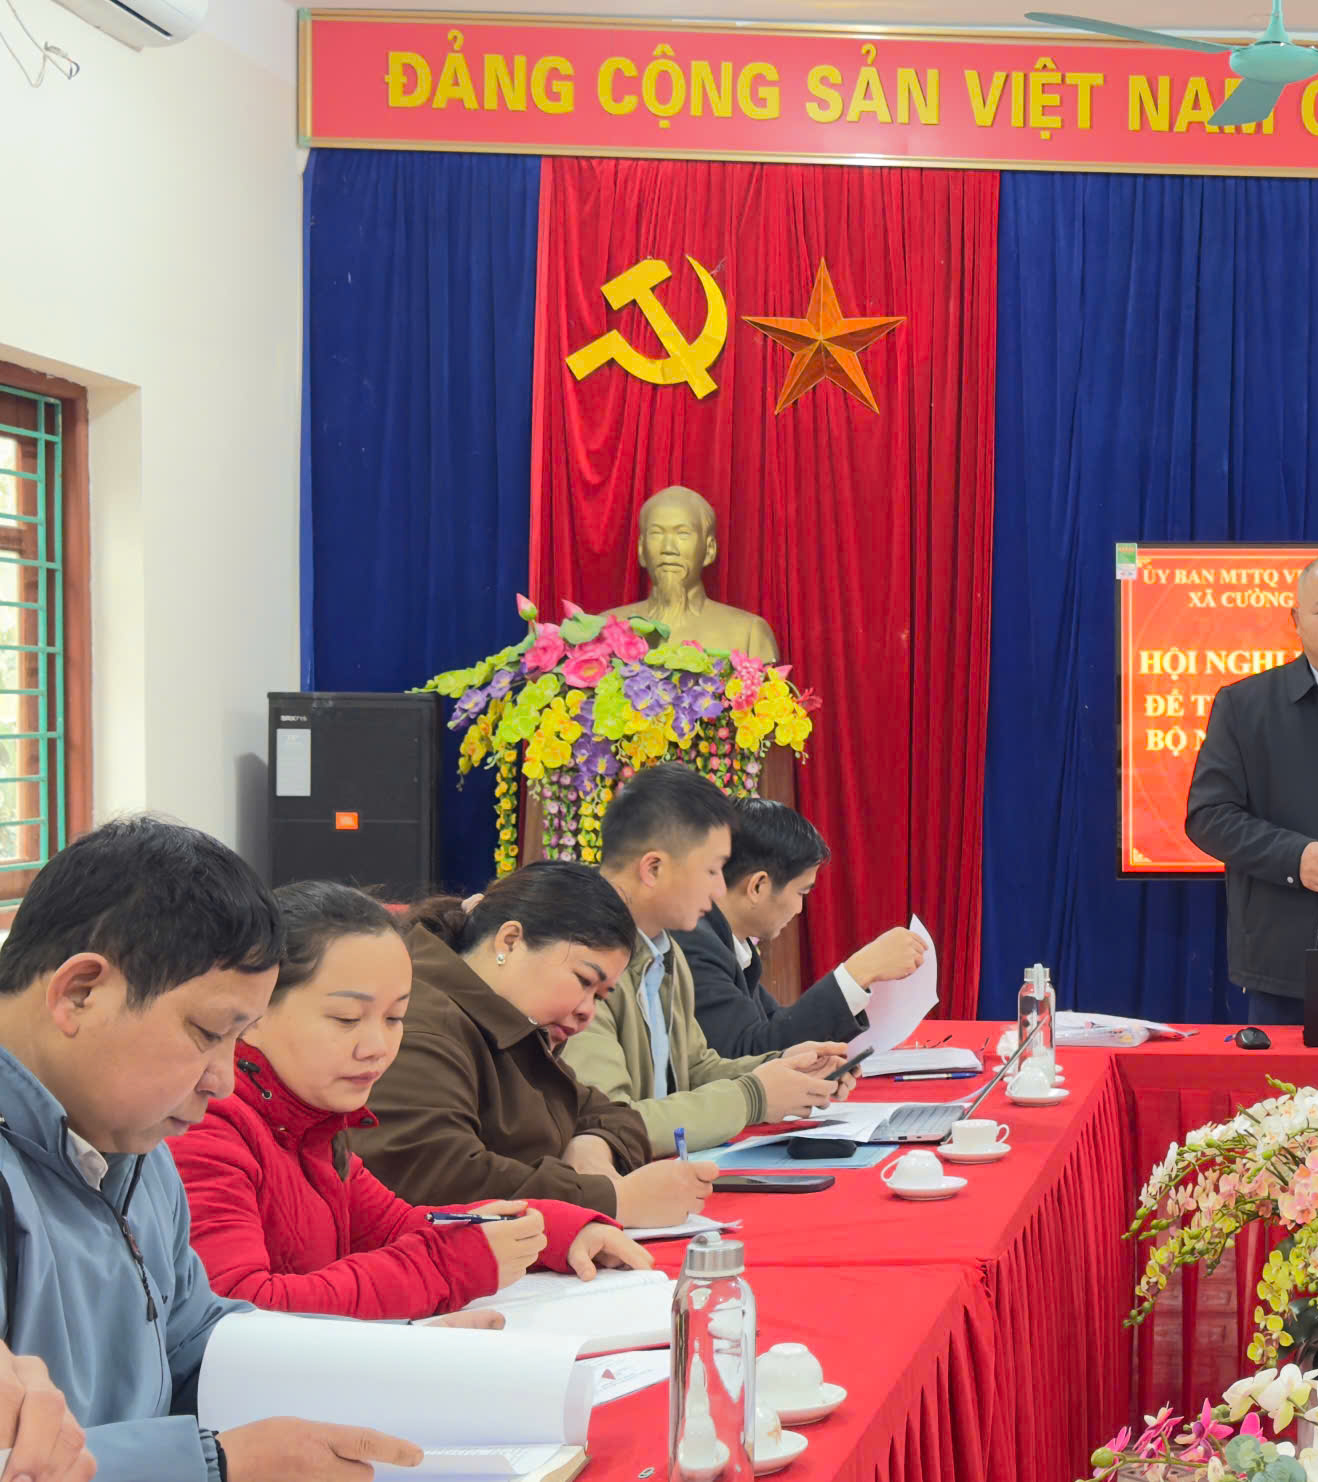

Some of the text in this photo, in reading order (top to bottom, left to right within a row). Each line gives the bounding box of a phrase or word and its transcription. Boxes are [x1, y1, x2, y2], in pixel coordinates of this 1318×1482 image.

[385, 29, 575, 114] ĐẢNG
[597, 43, 781, 129] CỘNG
[805, 43, 940, 124] SẢN
[964, 57, 1104, 140] VIỆT
[1174, 569, 1215, 585] BAN
[1219, 569, 1280, 587] MTTQ
[1188, 588, 1295, 608] XÃ CƯỜNG
[1139, 646, 1198, 681] HỘI
[1146, 725, 1188, 757] BỘ
